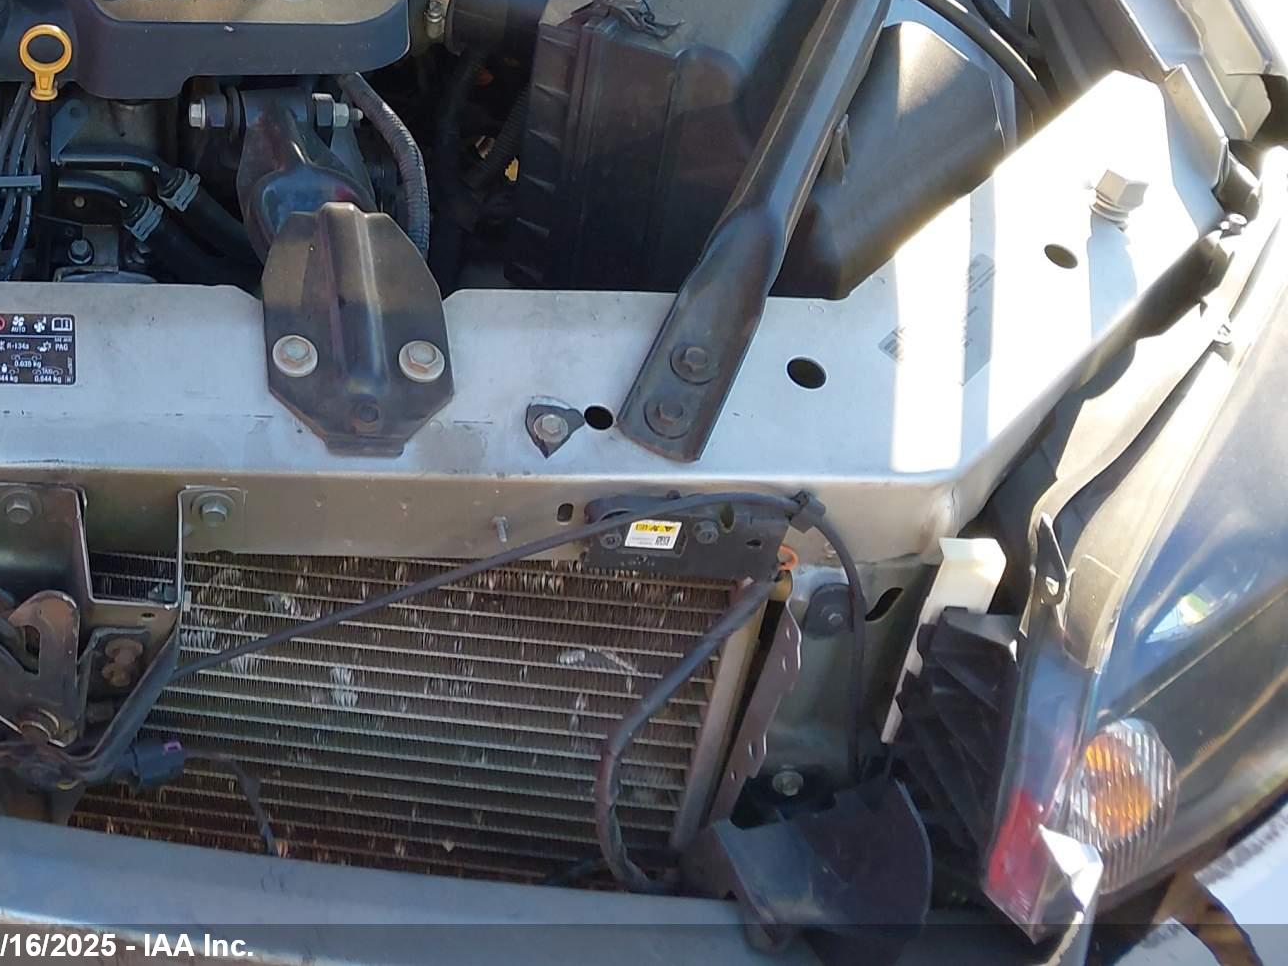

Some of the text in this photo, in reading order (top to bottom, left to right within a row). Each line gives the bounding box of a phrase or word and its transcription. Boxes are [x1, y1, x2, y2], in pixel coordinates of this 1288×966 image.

[7, 343, 30, 351] R-134a
[55, 343, 69, 351] PAG
[33, 360, 42, 369] kg
[9, 373, 19, 383] kg
[53, 374, 62, 384] kg
